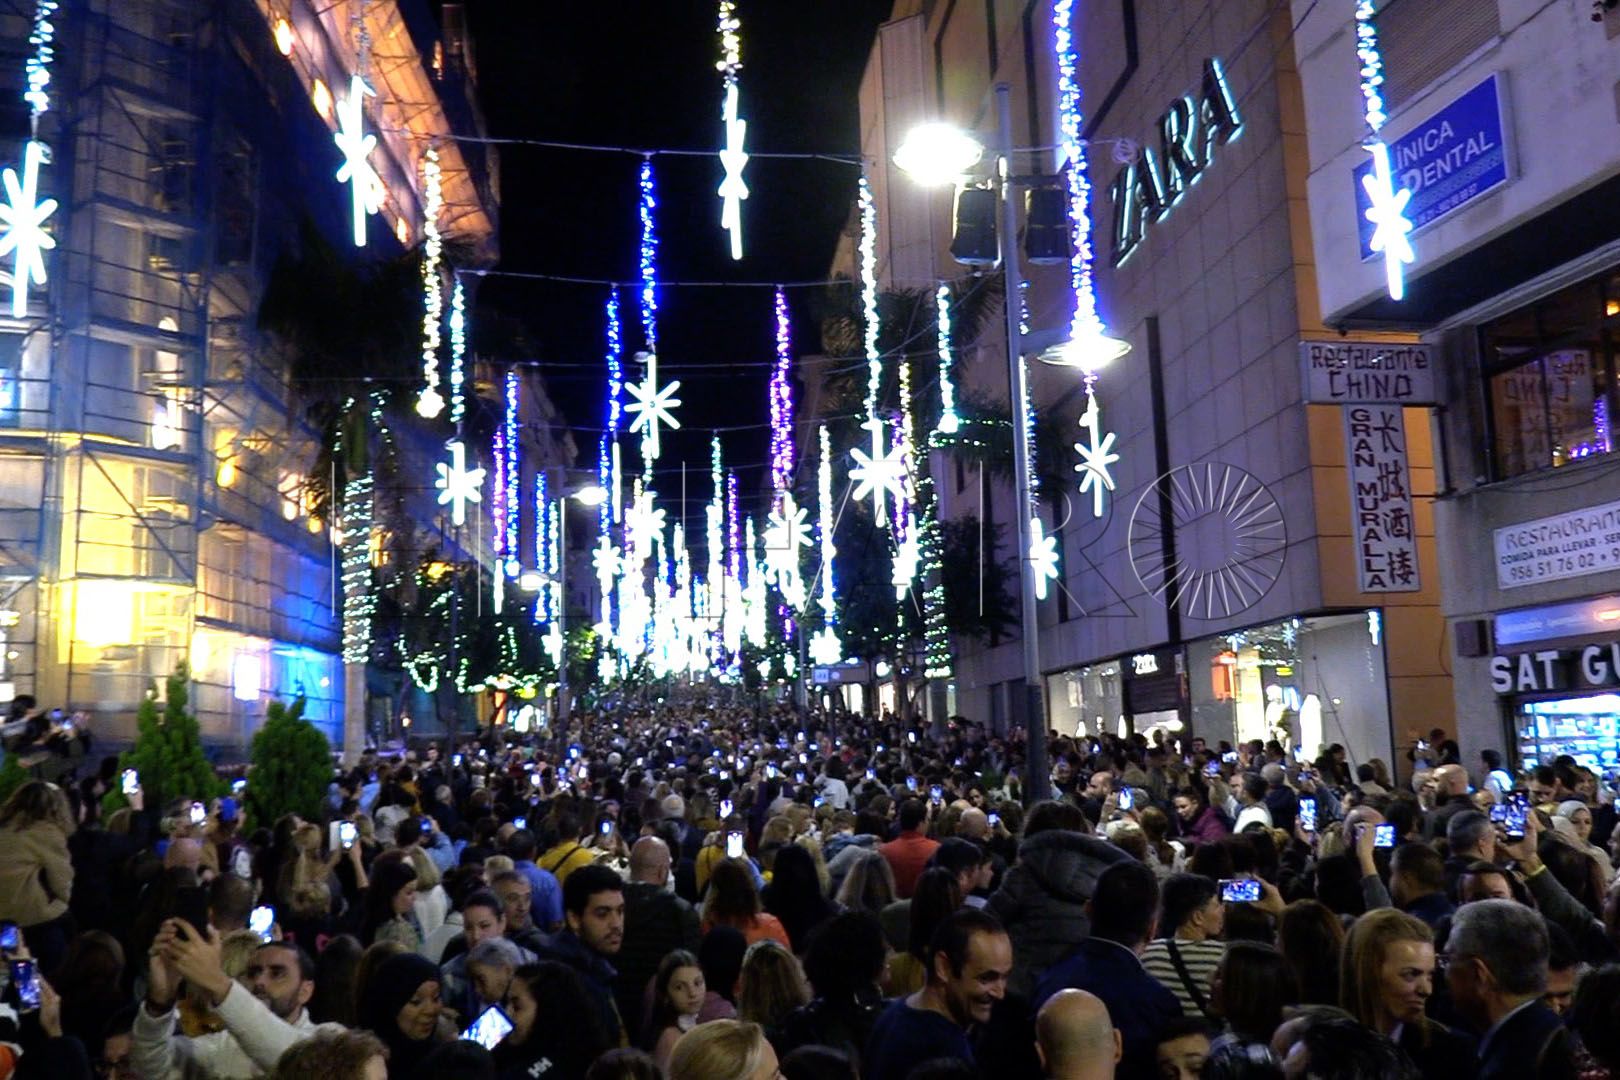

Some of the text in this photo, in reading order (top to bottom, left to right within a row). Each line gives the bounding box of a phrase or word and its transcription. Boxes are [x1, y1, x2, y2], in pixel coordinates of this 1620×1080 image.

[1109, 57, 1243, 268] ZARA
[1391, 120, 1454, 175] ÍNICA
[1401, 131, 1494, 194] DENTAL
[1328, 369, 1412, 398] CHINO
[1350, 408, 1387, 588] GRAN MURALLA
[1501, 551, 1535, 566] COMIDA
[1537, 545, 1560, 557] PARA
[1562, 537, 1597, 553] LLEVAR
[1510, 565, 1533, 580] 956
[1538, 560, 1552, 576] 51
[1557, 557, 1574, 572] 76
[1578, 552, 1596, 569] 02
[1489, 650, 1559, 693] SAT
